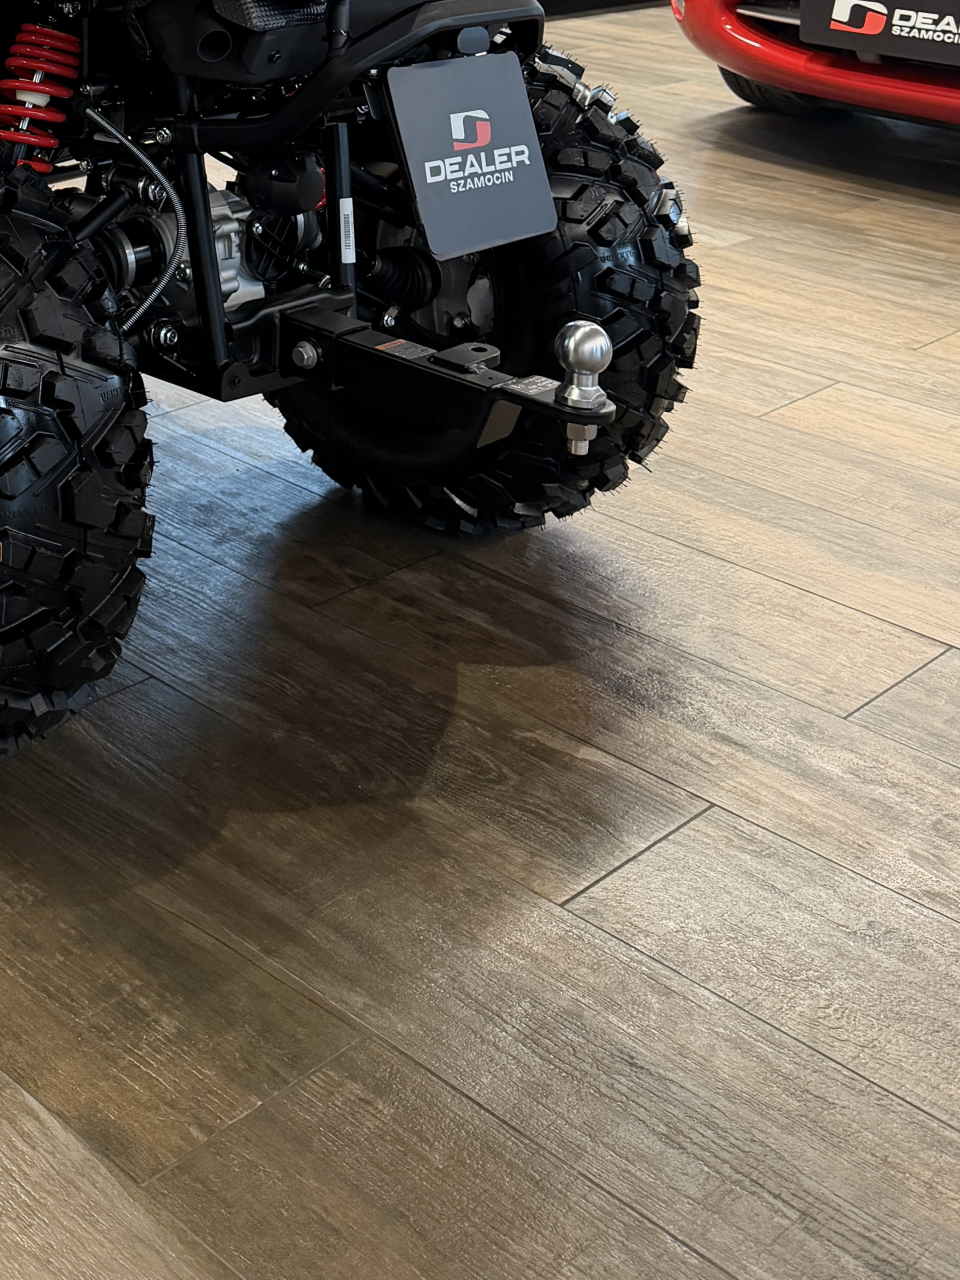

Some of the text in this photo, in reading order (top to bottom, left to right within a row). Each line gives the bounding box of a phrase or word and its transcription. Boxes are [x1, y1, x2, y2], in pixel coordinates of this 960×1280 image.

[891, 8, 960, 34] DEA
[891, 26, 960, 45] SZAMOCI
[424, 144, 530, 184] DEALER
[449, 170, 514, 193] SZAMOCIN
